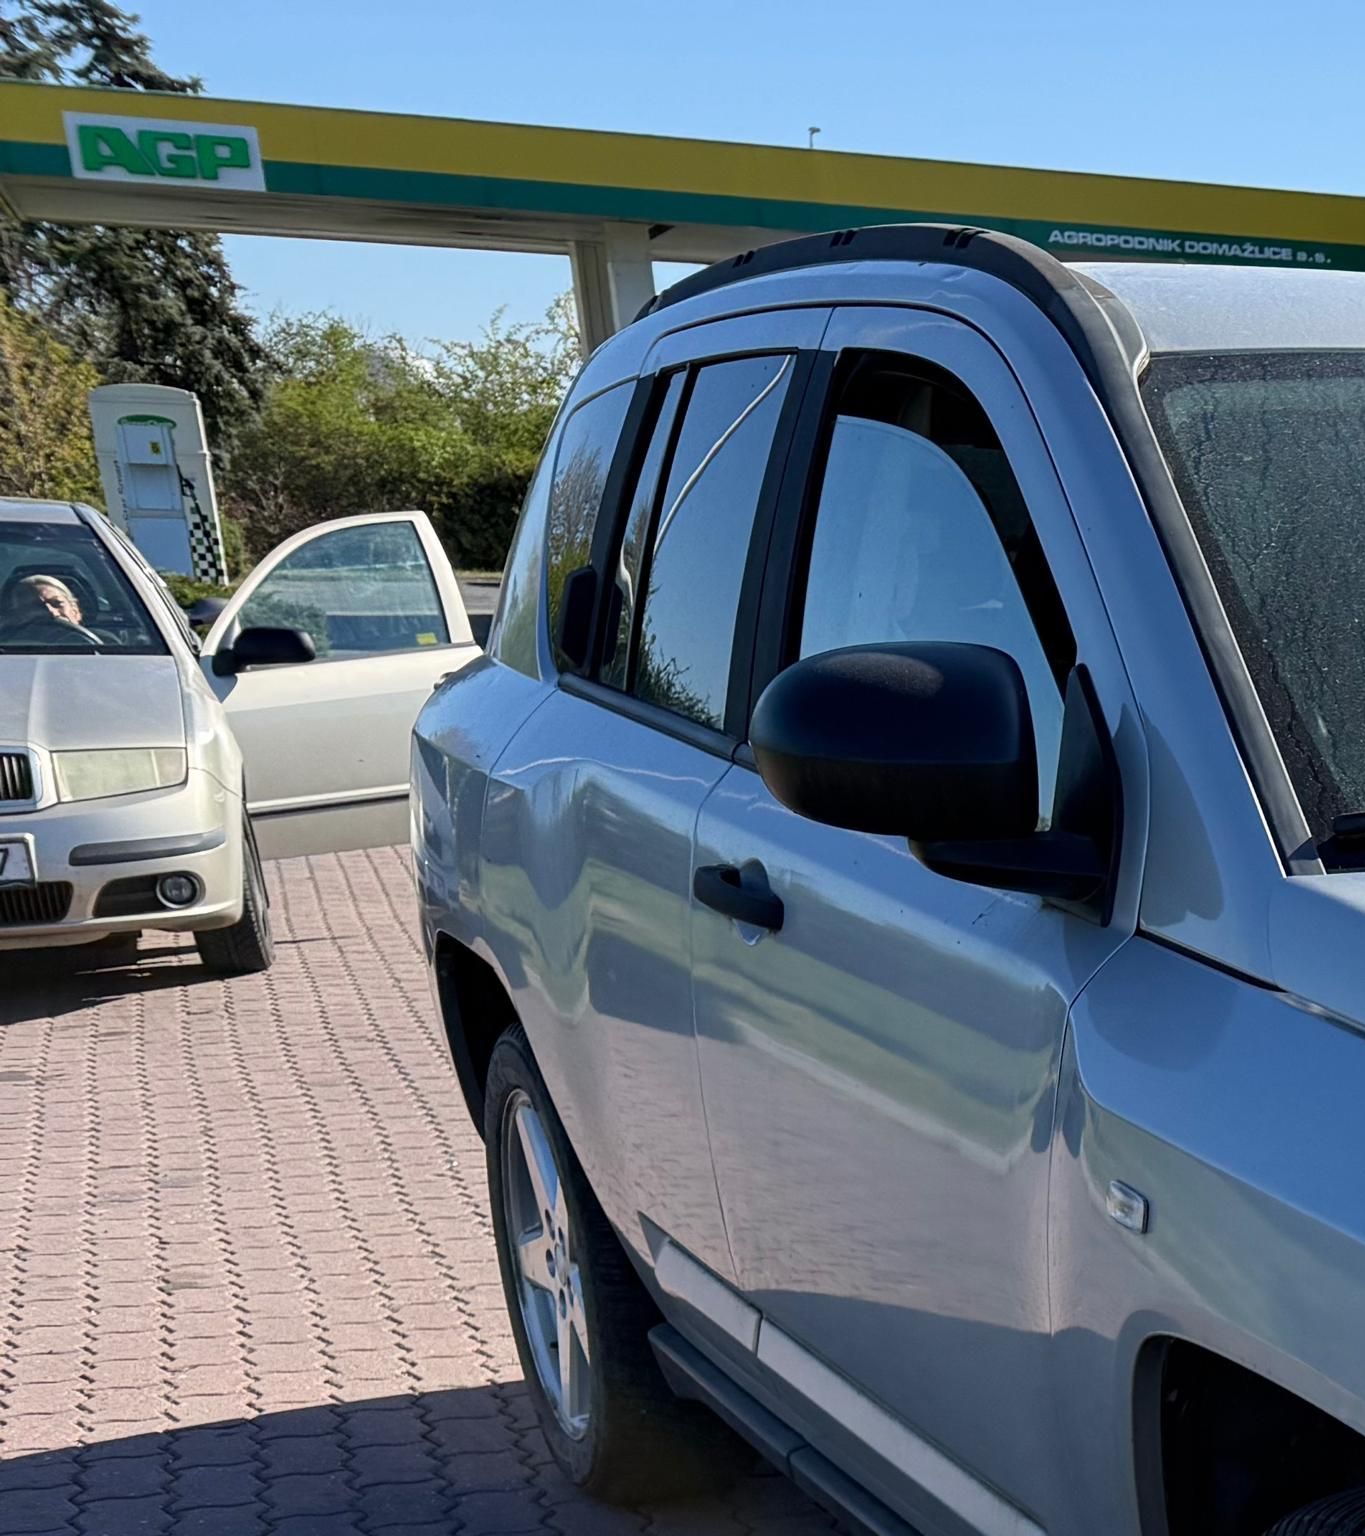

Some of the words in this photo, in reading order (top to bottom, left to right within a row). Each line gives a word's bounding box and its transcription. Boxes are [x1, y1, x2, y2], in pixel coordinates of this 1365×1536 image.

[78, 125, 251, 180] AGP
[1048, 229, 1182, 253] AGROPODNIK
[1184, 240, 1292, 260] DOMAŽLICE
